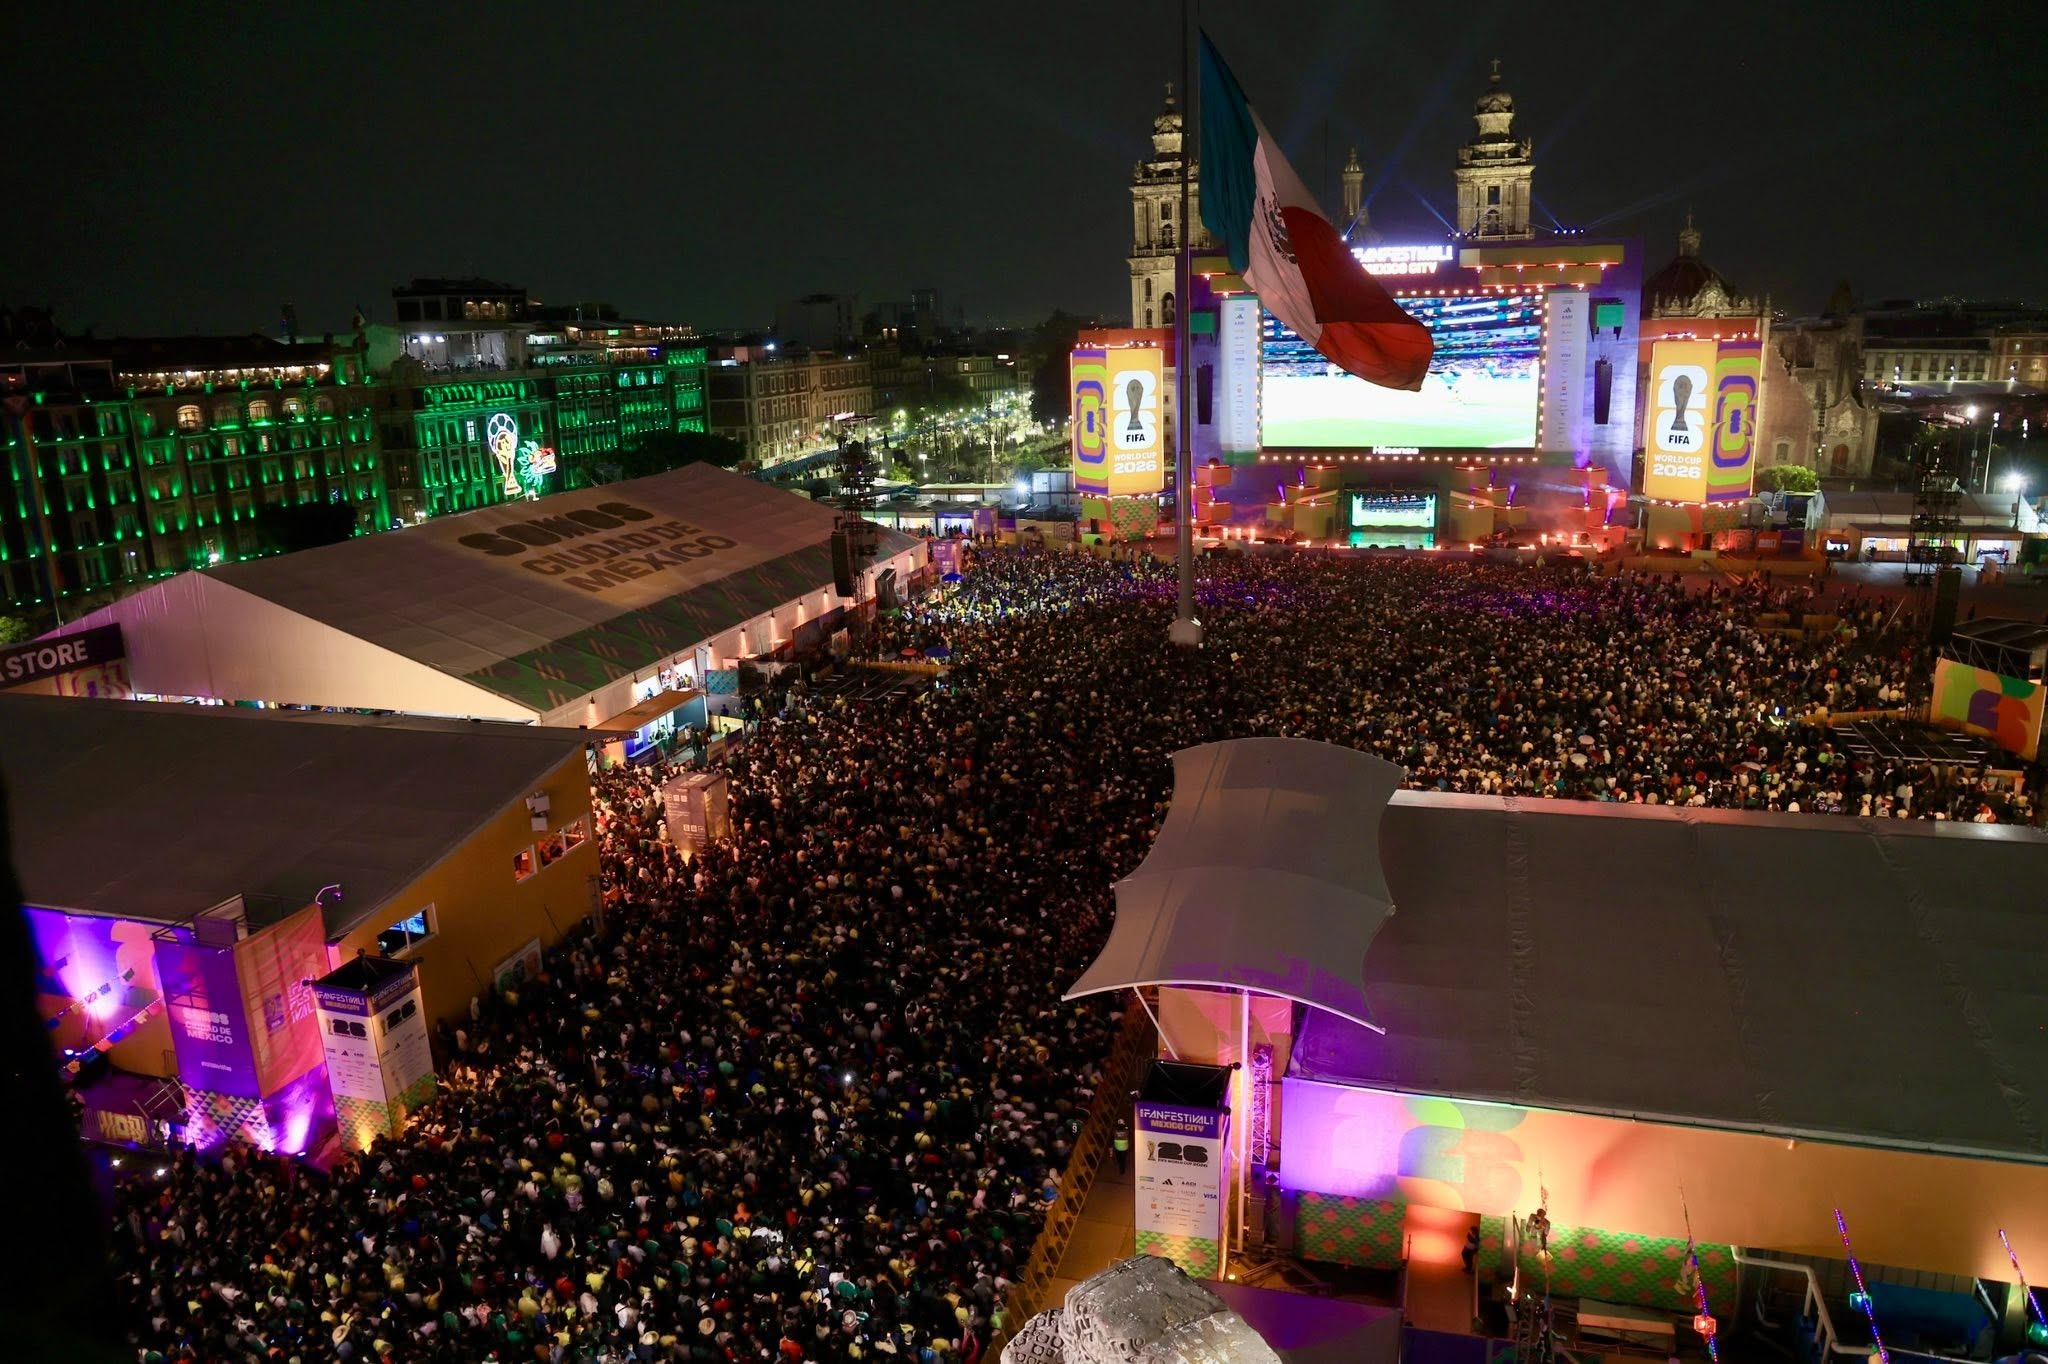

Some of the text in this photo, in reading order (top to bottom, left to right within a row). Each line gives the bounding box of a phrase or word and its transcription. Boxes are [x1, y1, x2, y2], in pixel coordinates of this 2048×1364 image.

[1408, 261, 1438, 275] CITY
[1126, 433, 1146, 443] FIFA
[1668, 434, 1690, 445] FIFA
[1114, 451, 1157, 462] WORLD CUP
[1654, 453, 1702, 465] WORLD CUP
[1113, 460, 1158, 474] 2026
[1652, 462, 1702, 479] 2026
[457, 502, 655, 557] SOMOS
[520, 520, 703, 576] CIUDAD DE
[6, 639, 89, 679] STORE
[219, 1026, 232, 1036] DE
[332, 1018, 367, 1037] 26
[1150, 1119, 1205, 1132] MEXICO CITY
[1157, 1141, 1208, 1164] 26
[1203, 1192, 1218, 1200] VISA
